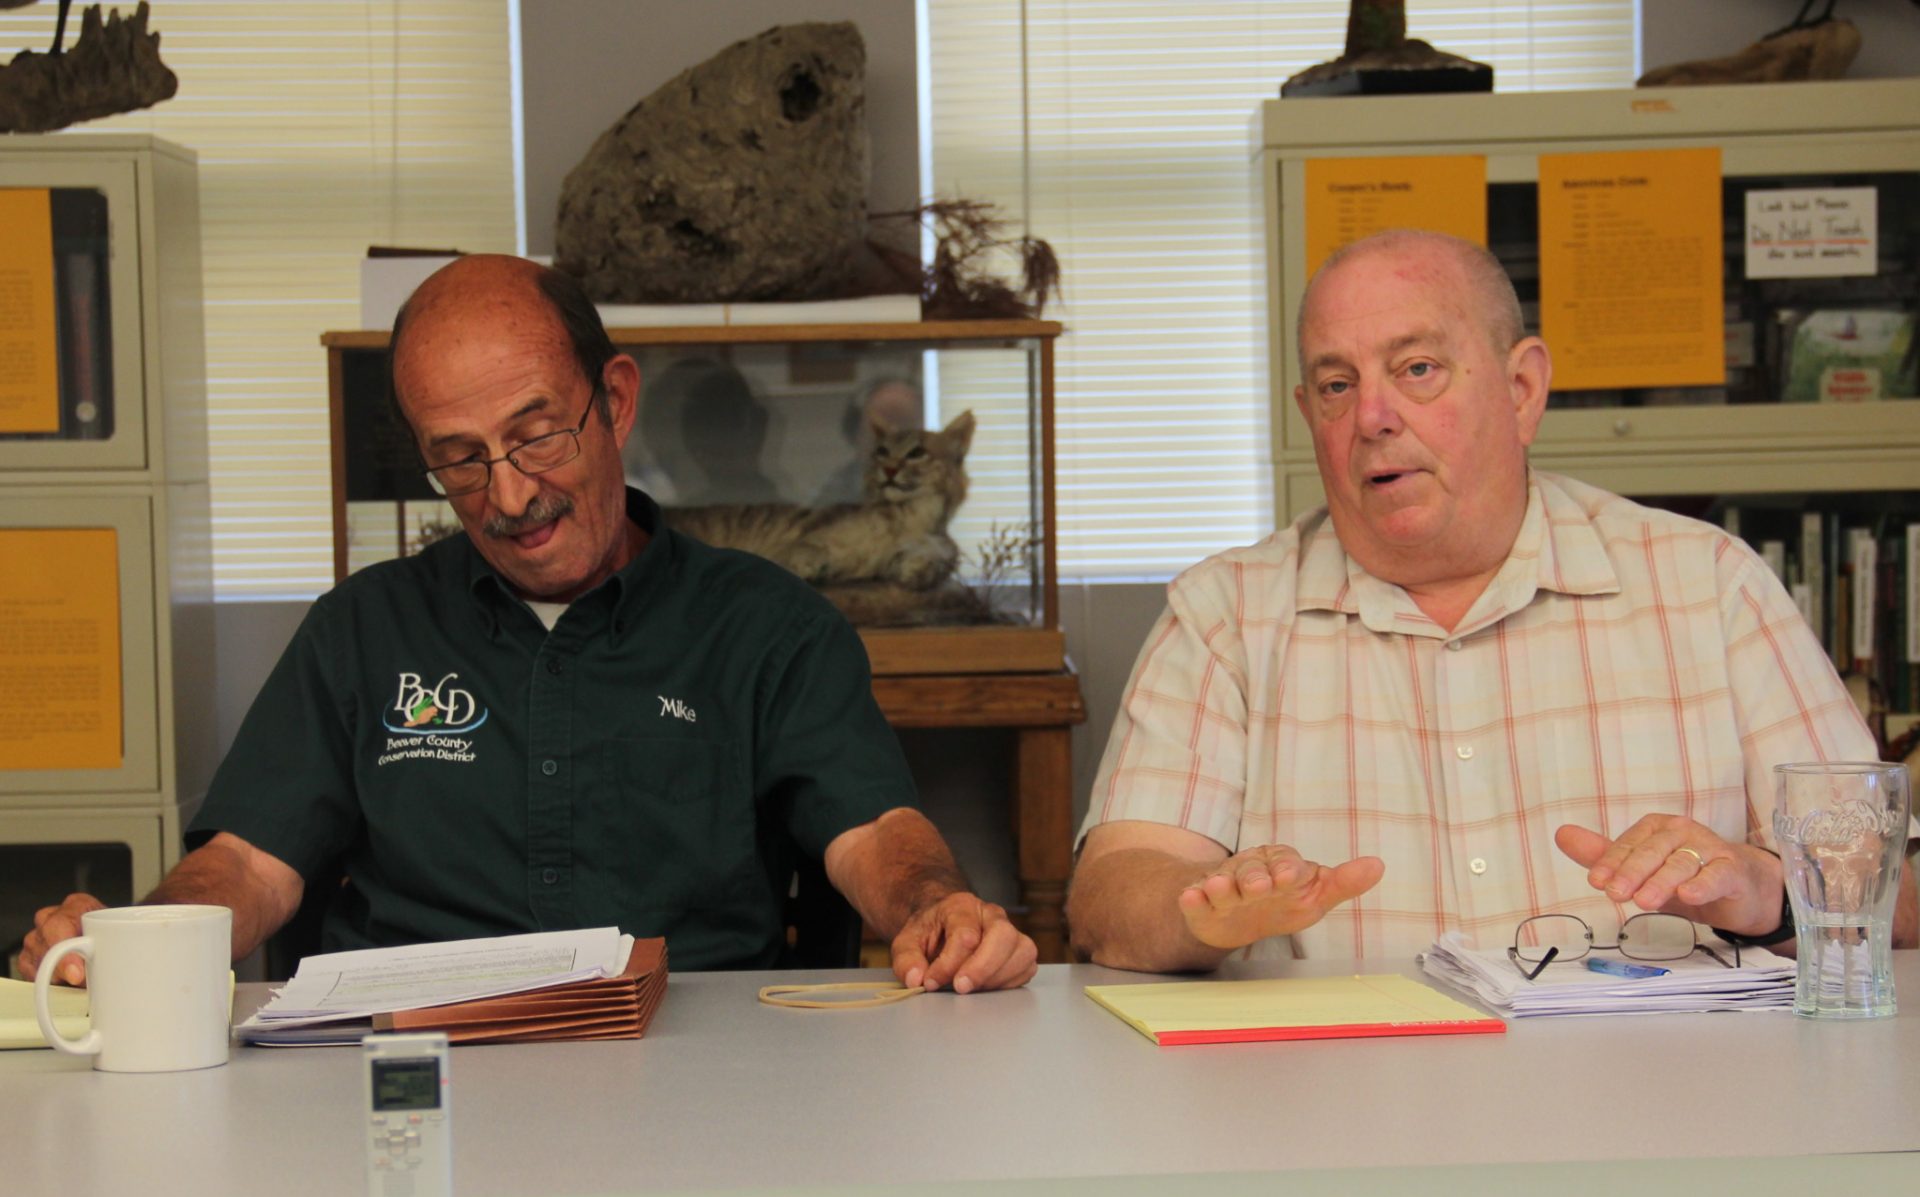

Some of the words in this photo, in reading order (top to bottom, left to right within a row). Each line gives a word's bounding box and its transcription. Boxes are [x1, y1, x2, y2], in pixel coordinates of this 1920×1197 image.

[657, 695, 697, 723] Mike
[386, 736, 424, 751] Beaver
[426, 734, 473, 753] County
[378, 748, 435, 766] Conservation
[436, 748, 477, 763] District
